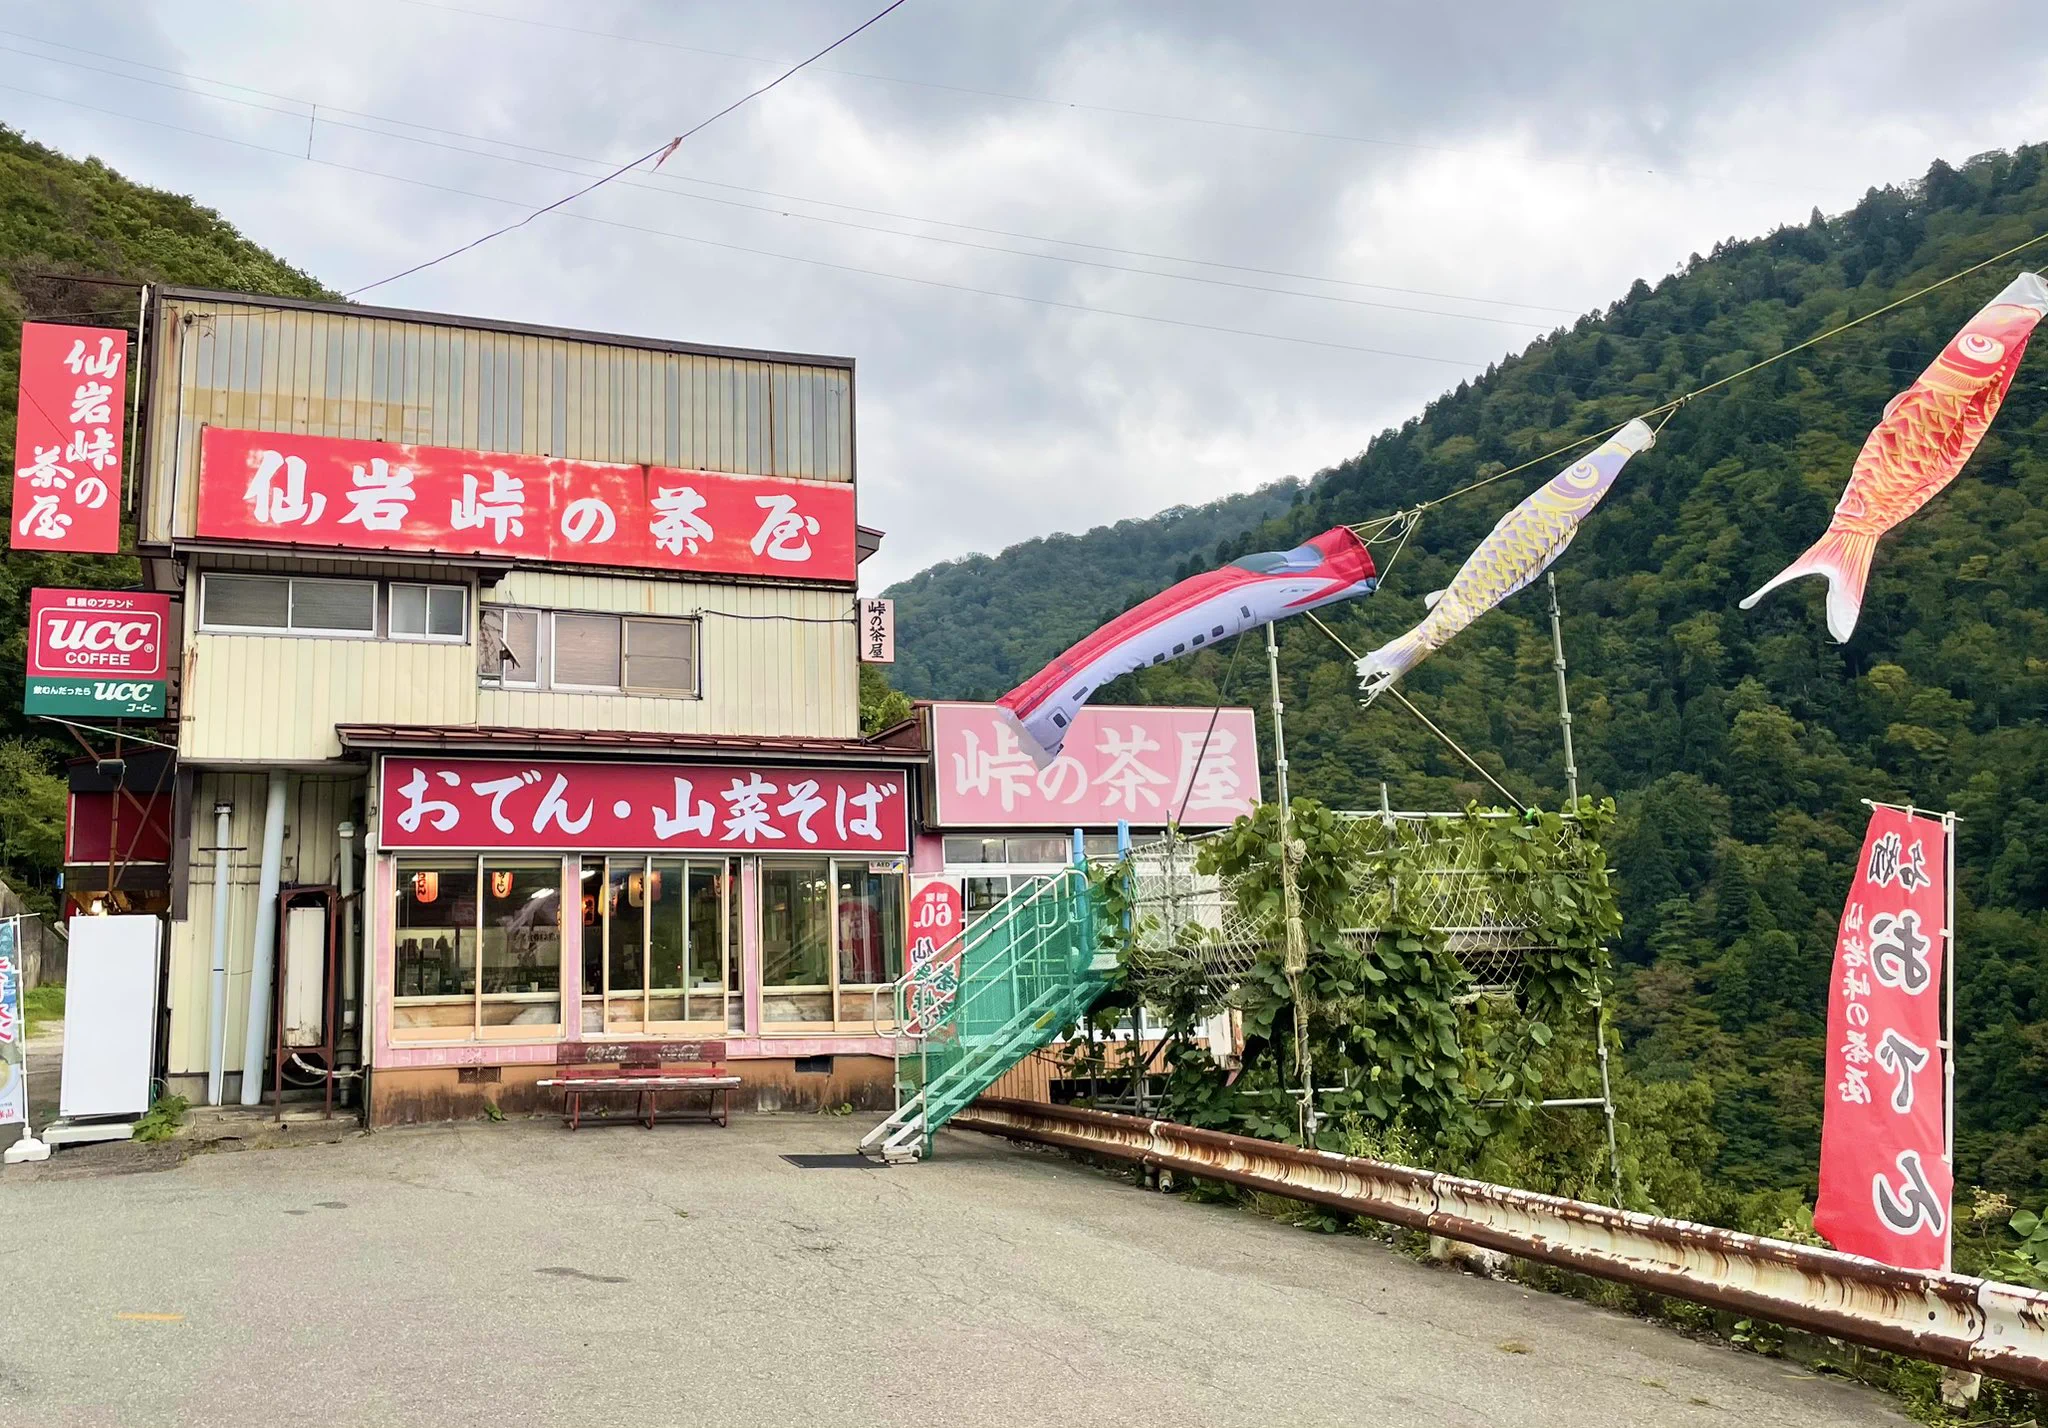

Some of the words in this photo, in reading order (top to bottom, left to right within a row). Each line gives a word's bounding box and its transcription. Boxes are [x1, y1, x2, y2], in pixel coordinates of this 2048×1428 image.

[64, 336, 122, 509] 仙岩峠の
[17, 446, 75, 539] 茶屋
[243, 450, 821, 561] 仙岩峠の茶屋
[65, 652, 131, 666] COFFEE
[868, 601, 886, 659] 峠の茶屋
[126, 703, 157, 713] コーヒー
[397, 767, 899, 844] おでん・山菜そば
[952, 720, 1249, 813] 峠の茶屋
